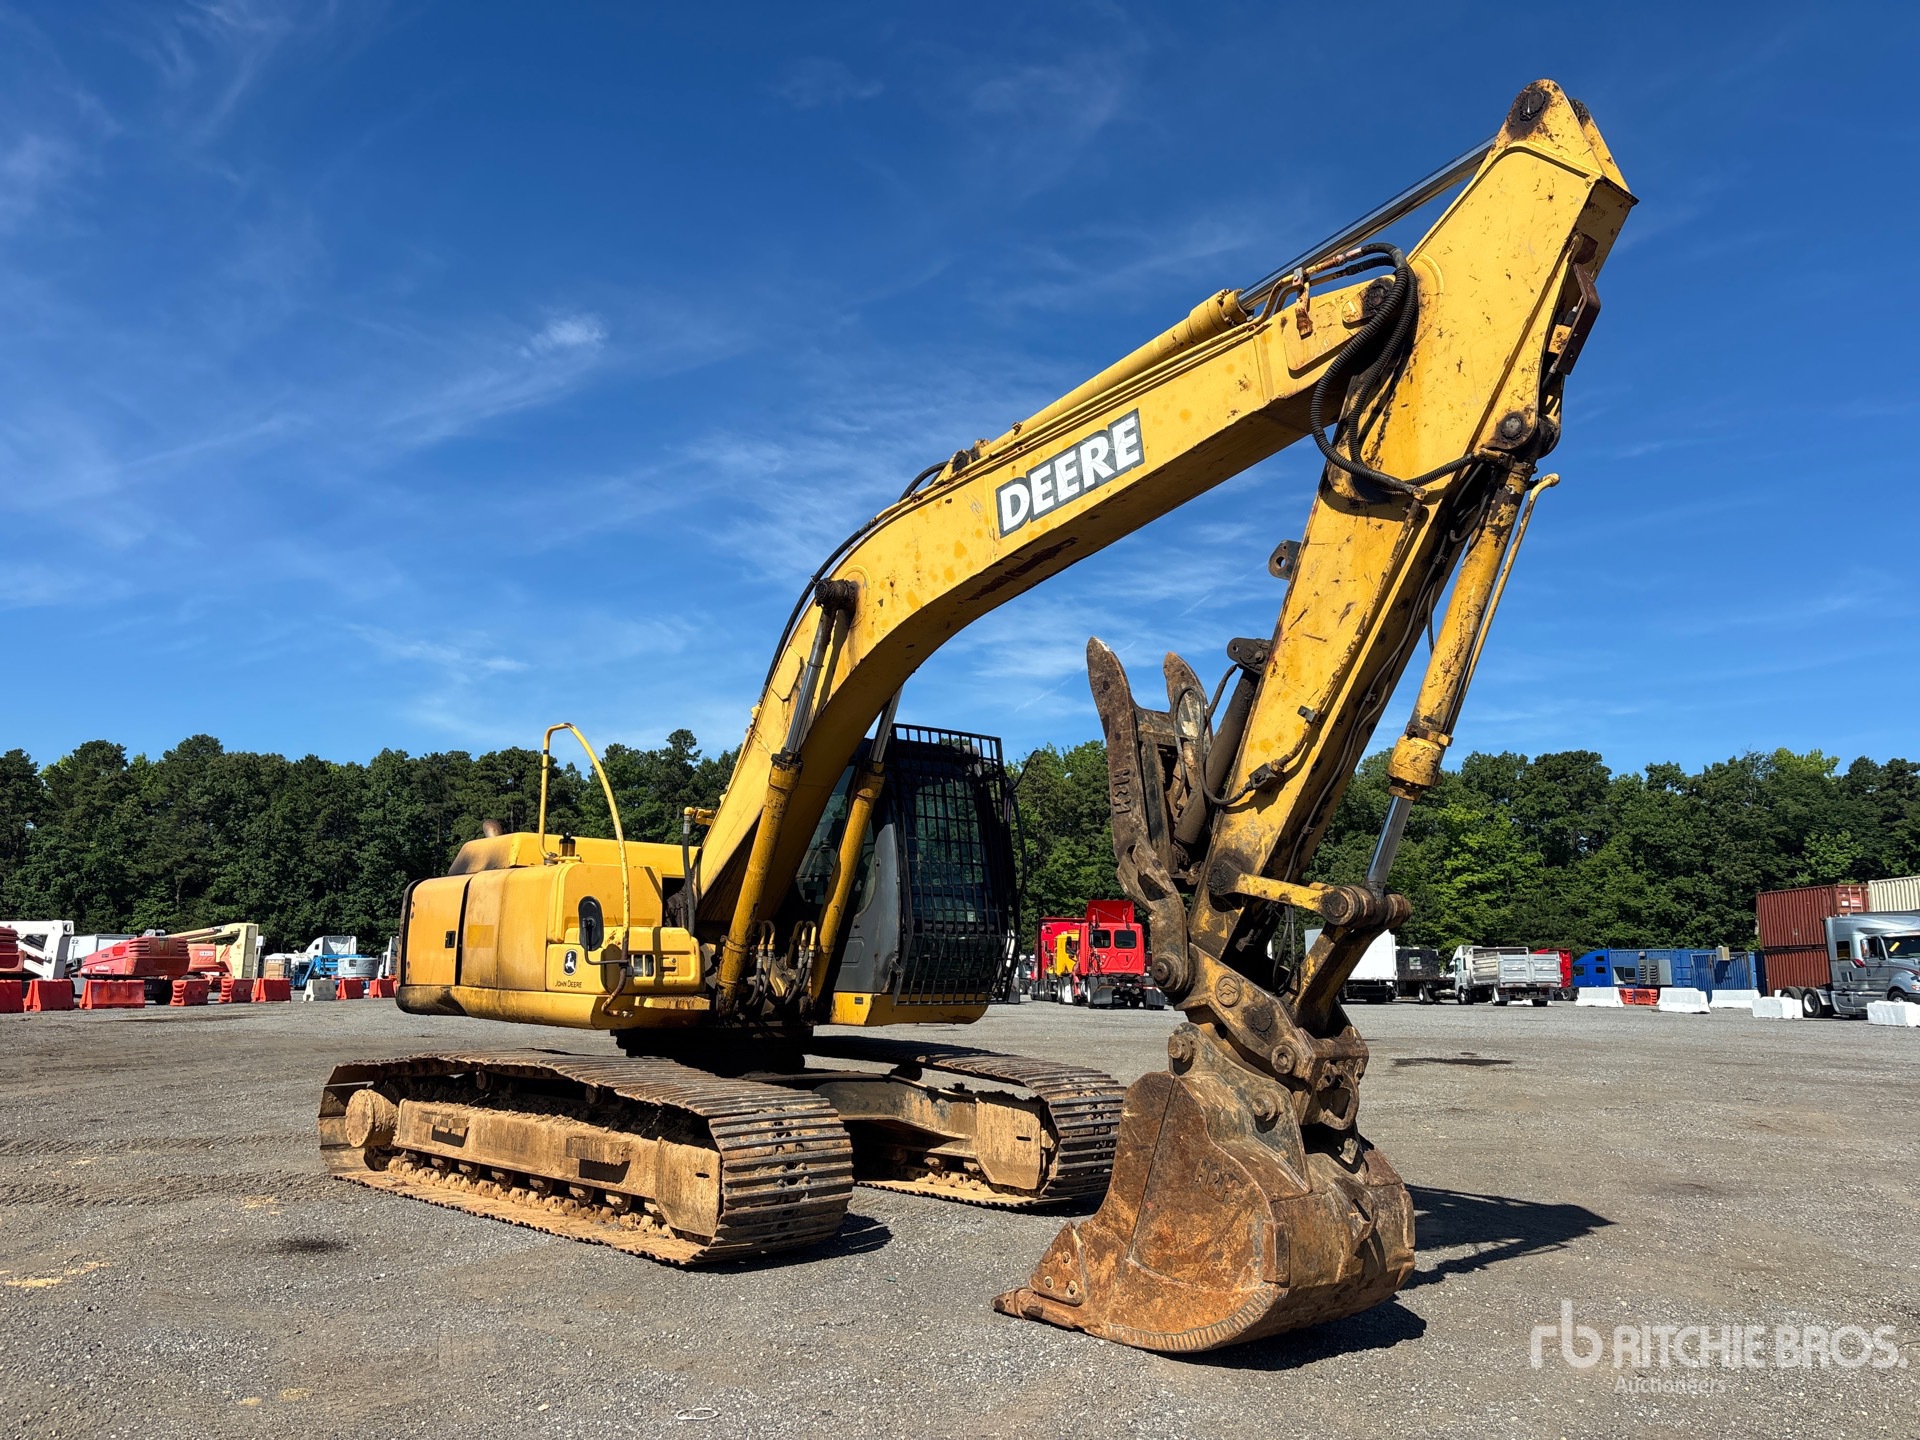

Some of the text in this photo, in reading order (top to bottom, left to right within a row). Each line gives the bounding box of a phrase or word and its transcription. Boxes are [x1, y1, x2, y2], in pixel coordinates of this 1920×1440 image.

[998, 413, 1142, 535] DEERE
[555, 979, 582, 988] JOHN DEERE
